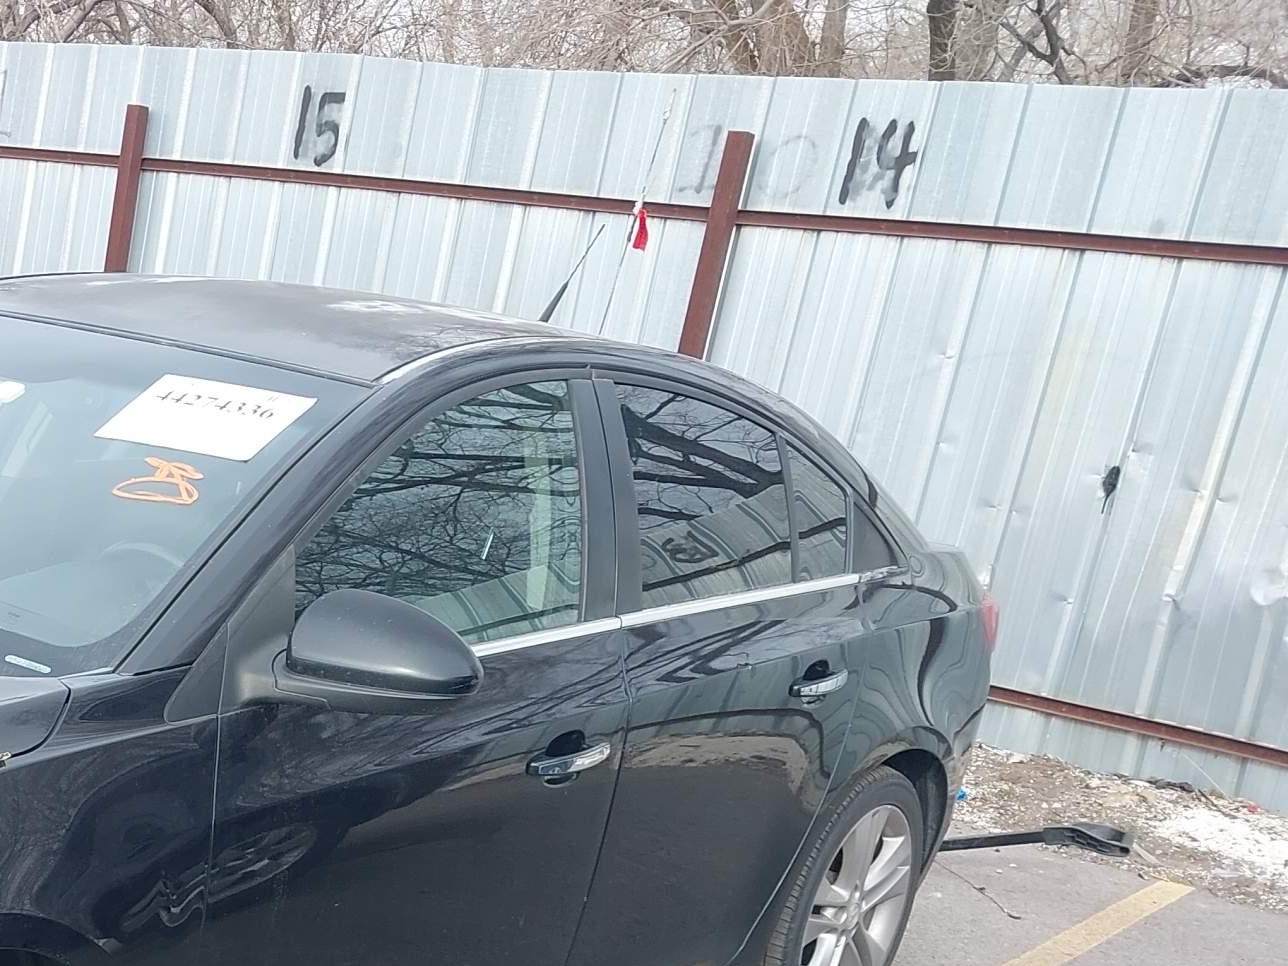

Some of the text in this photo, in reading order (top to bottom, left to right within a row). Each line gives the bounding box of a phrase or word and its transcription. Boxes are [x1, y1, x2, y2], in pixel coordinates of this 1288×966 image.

[293, 84, 347, 167] 15
[838, 116, 919, 210] 14
[155, 389, 276, 420] 44274336
